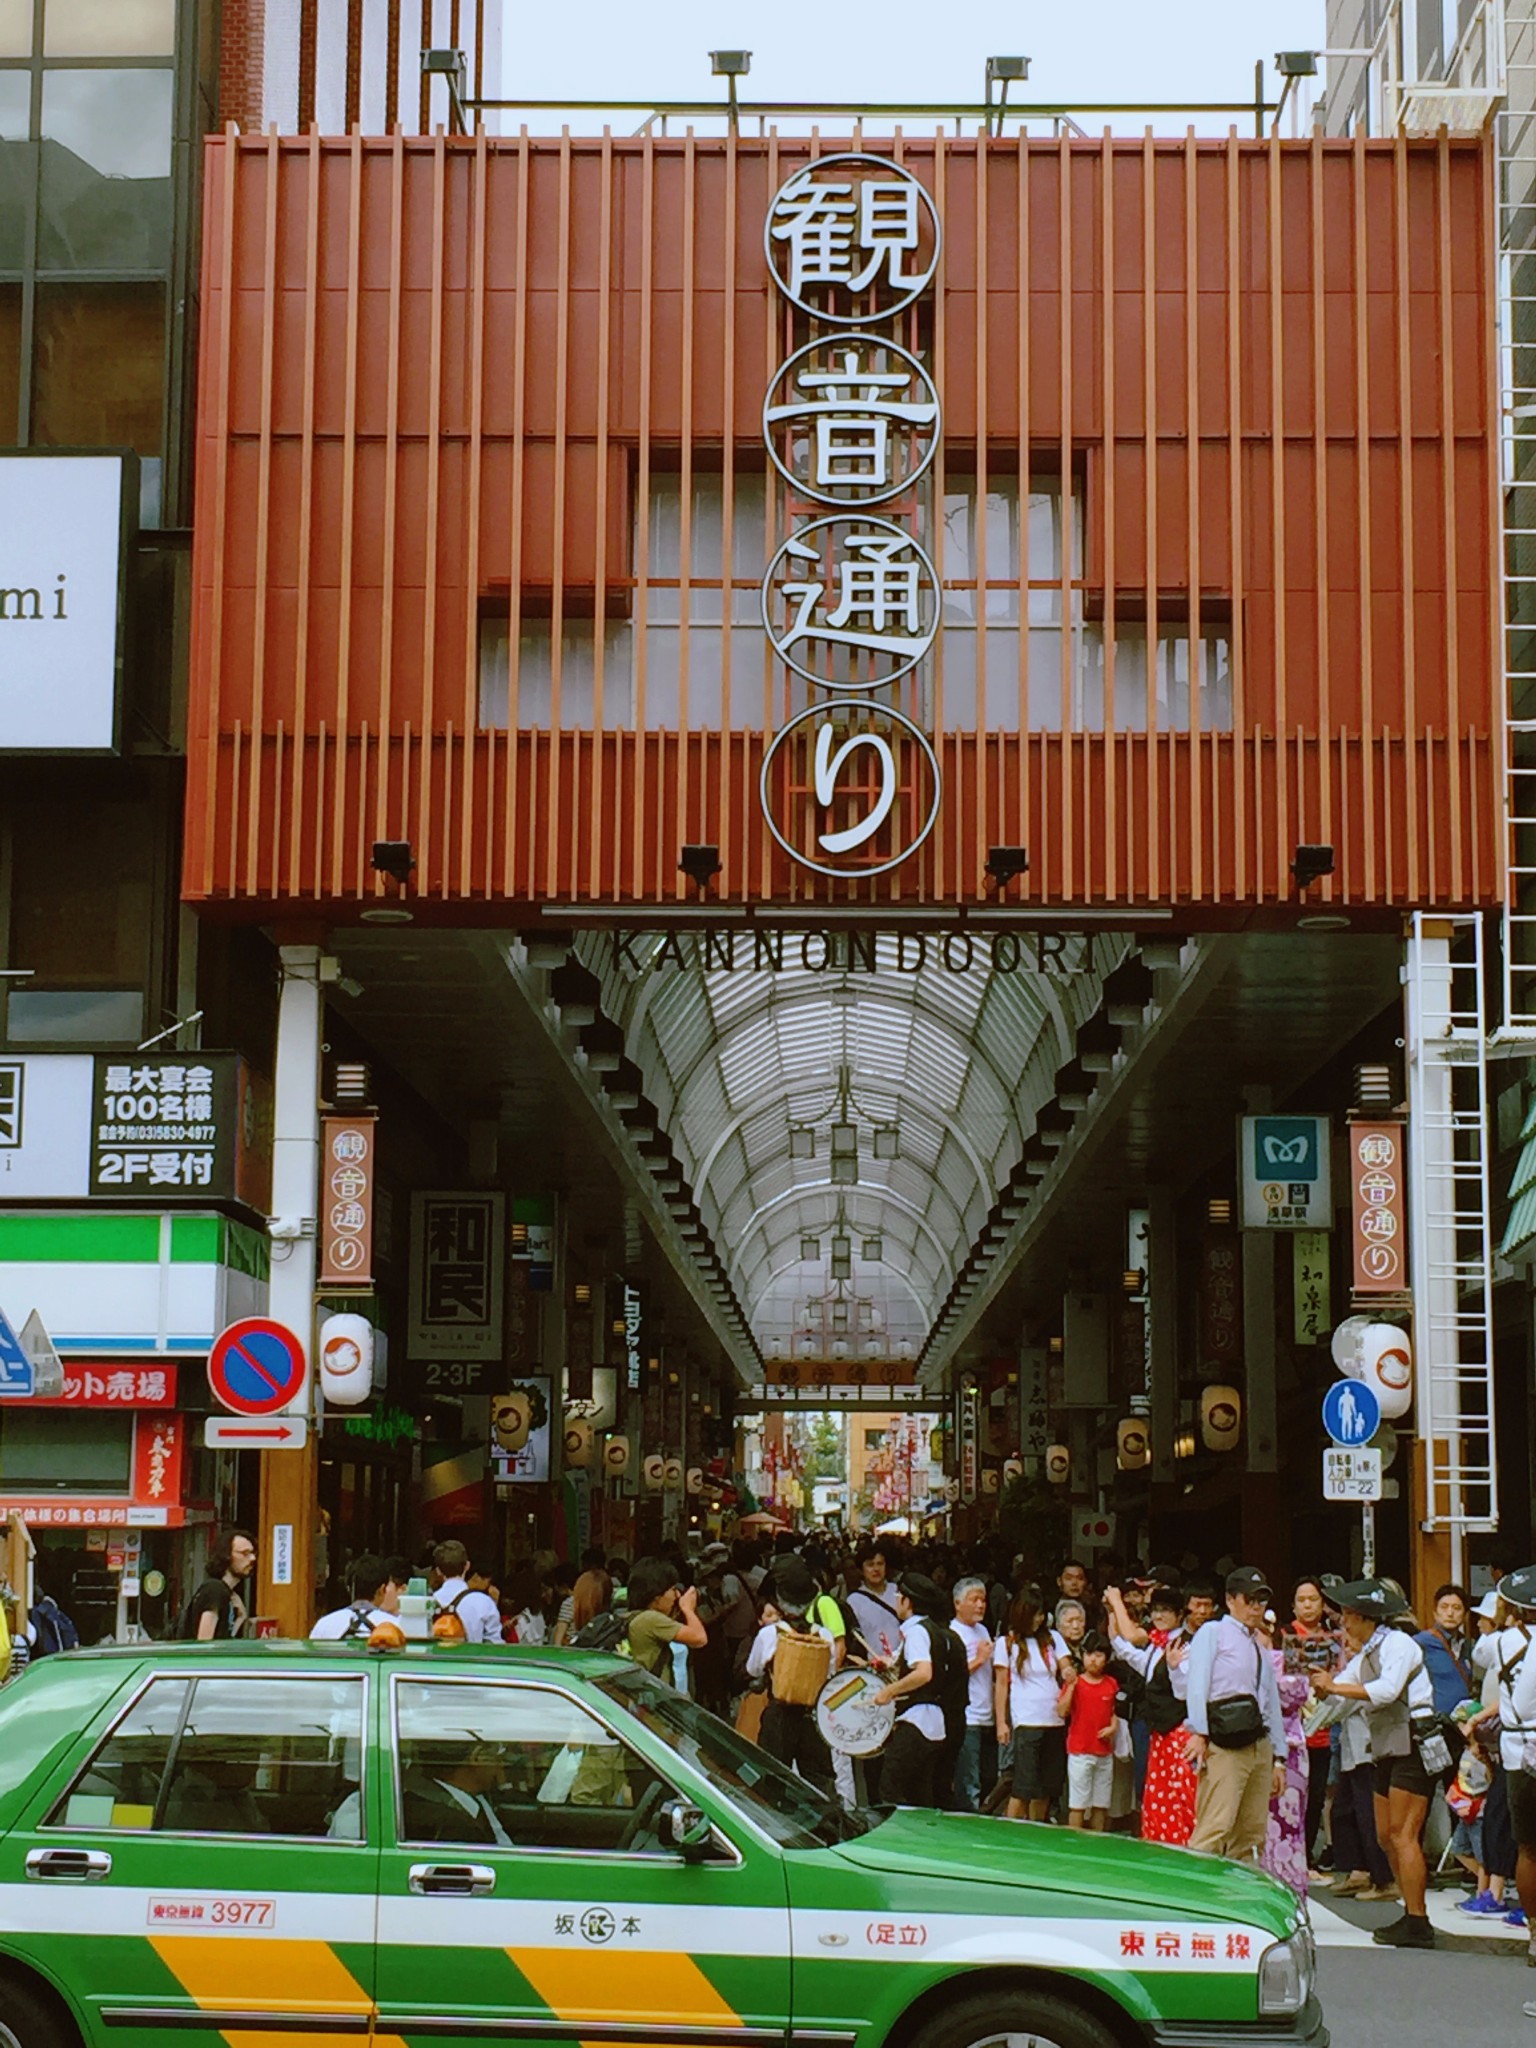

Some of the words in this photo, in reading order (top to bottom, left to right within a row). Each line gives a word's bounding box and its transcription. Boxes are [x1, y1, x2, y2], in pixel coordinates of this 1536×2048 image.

[764, 165, 939, 860] 観音通り
[612, 930, 1096, 974] KANNONDOORI
[104, 1065, 214, 1093] 最大宴会
[103, 1094, 213, 1122] 100名様
[98, 1152, 214, 1186] 2F受付
[333, 1133, 366, 1269] 観音通り
[1361, 1136, 1396, 1277] 観音通り
[153, 1904, 205, 1919] 東京無線
[211, 1901, 271, 1924] 3977
[1120, 1930, 1251, 1961] 東京無線
